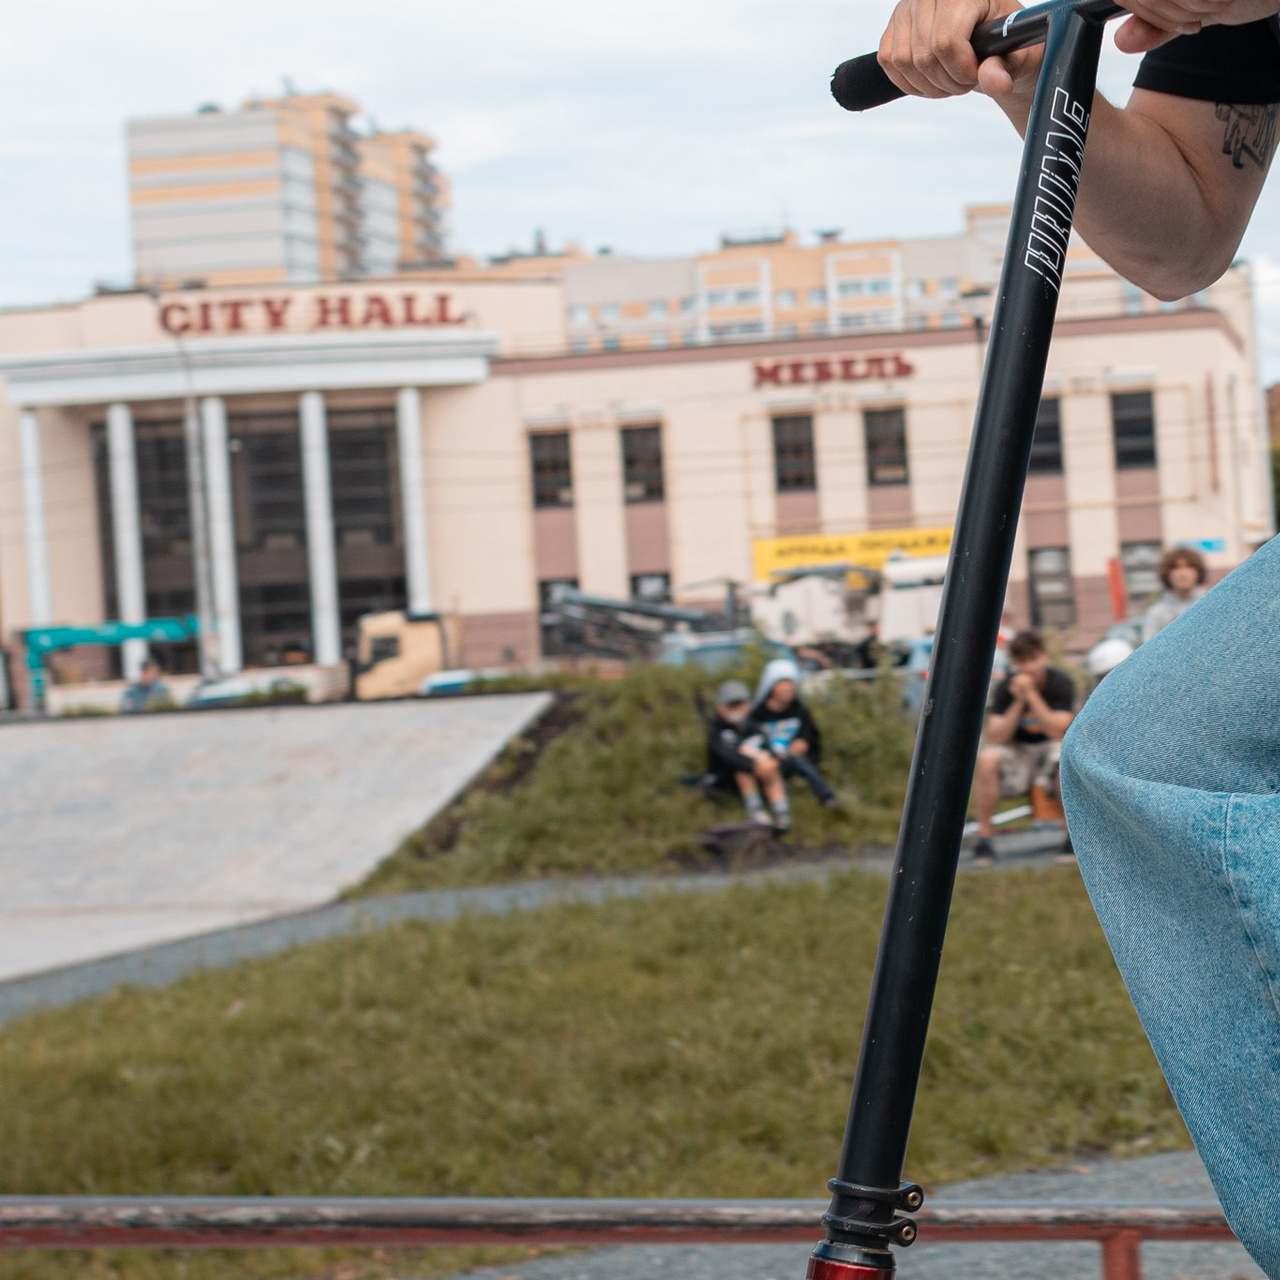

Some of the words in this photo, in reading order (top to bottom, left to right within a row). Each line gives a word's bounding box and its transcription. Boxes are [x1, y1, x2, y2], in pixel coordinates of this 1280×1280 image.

[158, 297, 290, 335] CITY
[315, 294, 468, 328] HALL
[755, 354, 914, 386] МЕБЕЛЬ
